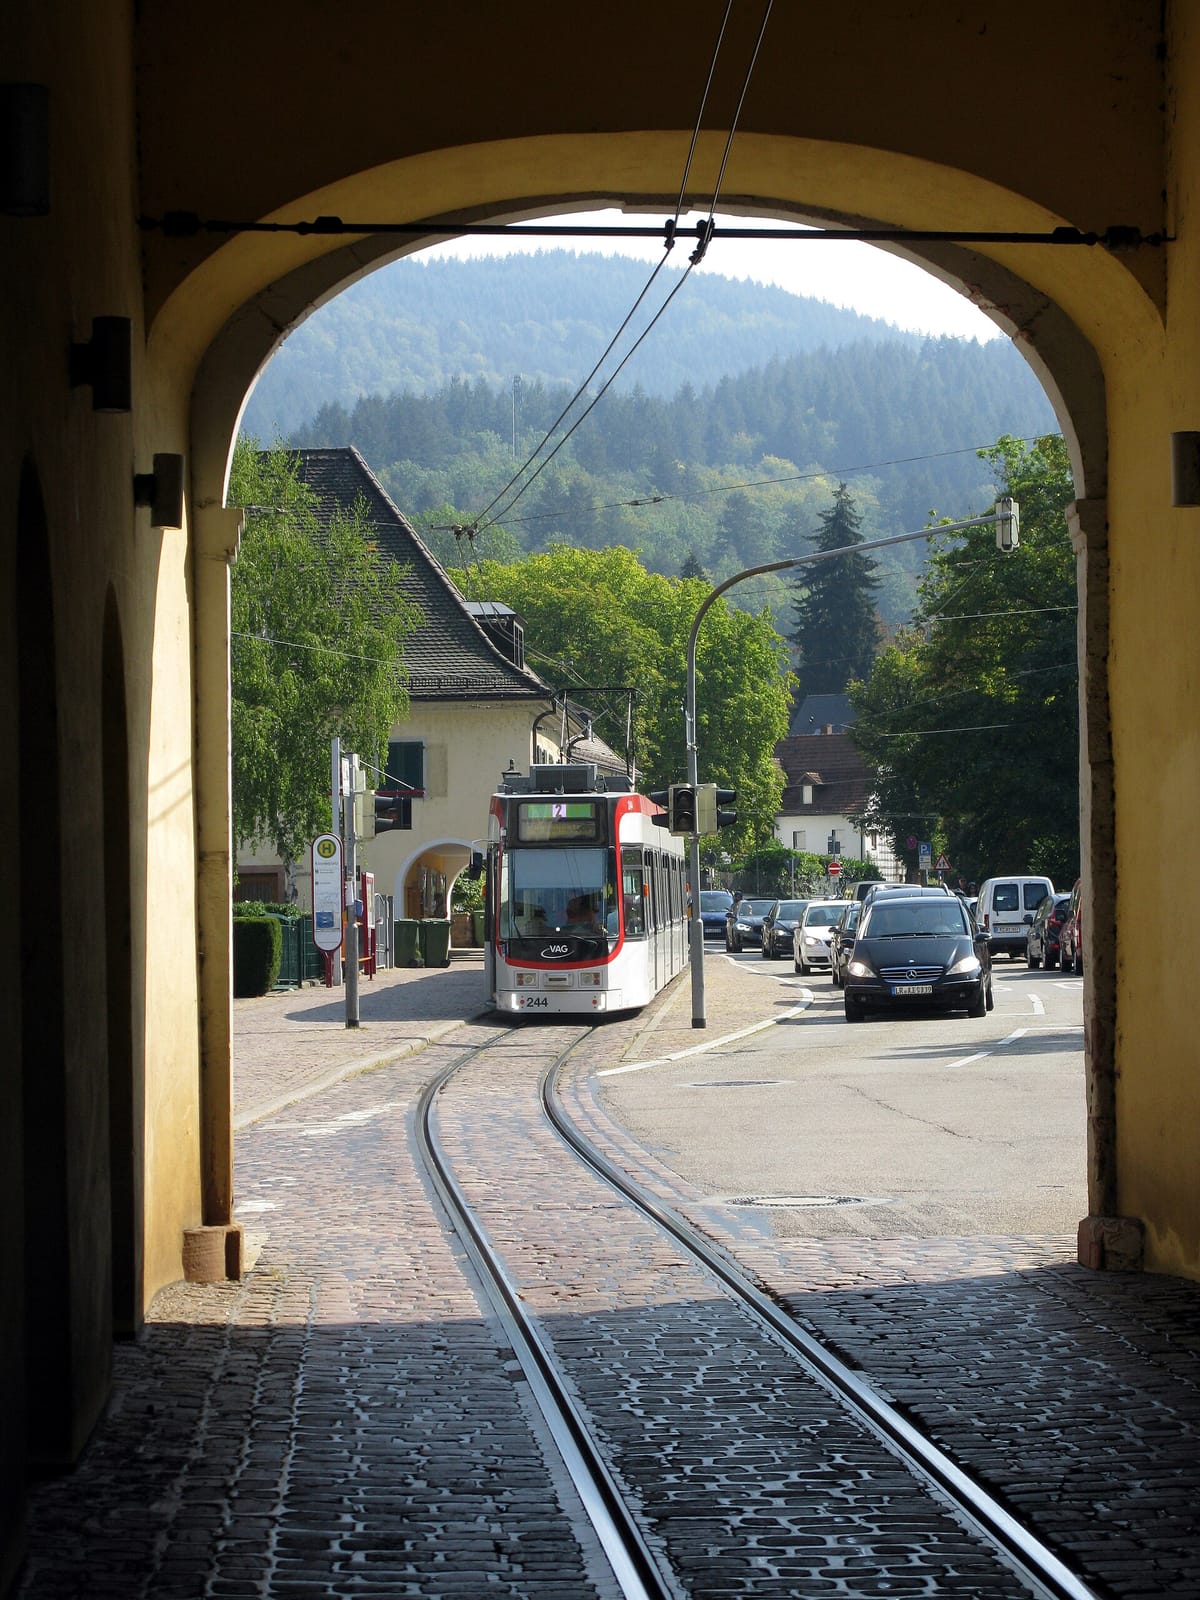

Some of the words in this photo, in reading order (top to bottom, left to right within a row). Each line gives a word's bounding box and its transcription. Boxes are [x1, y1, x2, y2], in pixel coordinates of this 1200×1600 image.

[555, 803, 562, 817] 2
[322, 843, 331, 854] H
[920, 845, 928, 854] P
[549, 945, 569, 953] VAG
[526, 997, 548, 1007] 244
